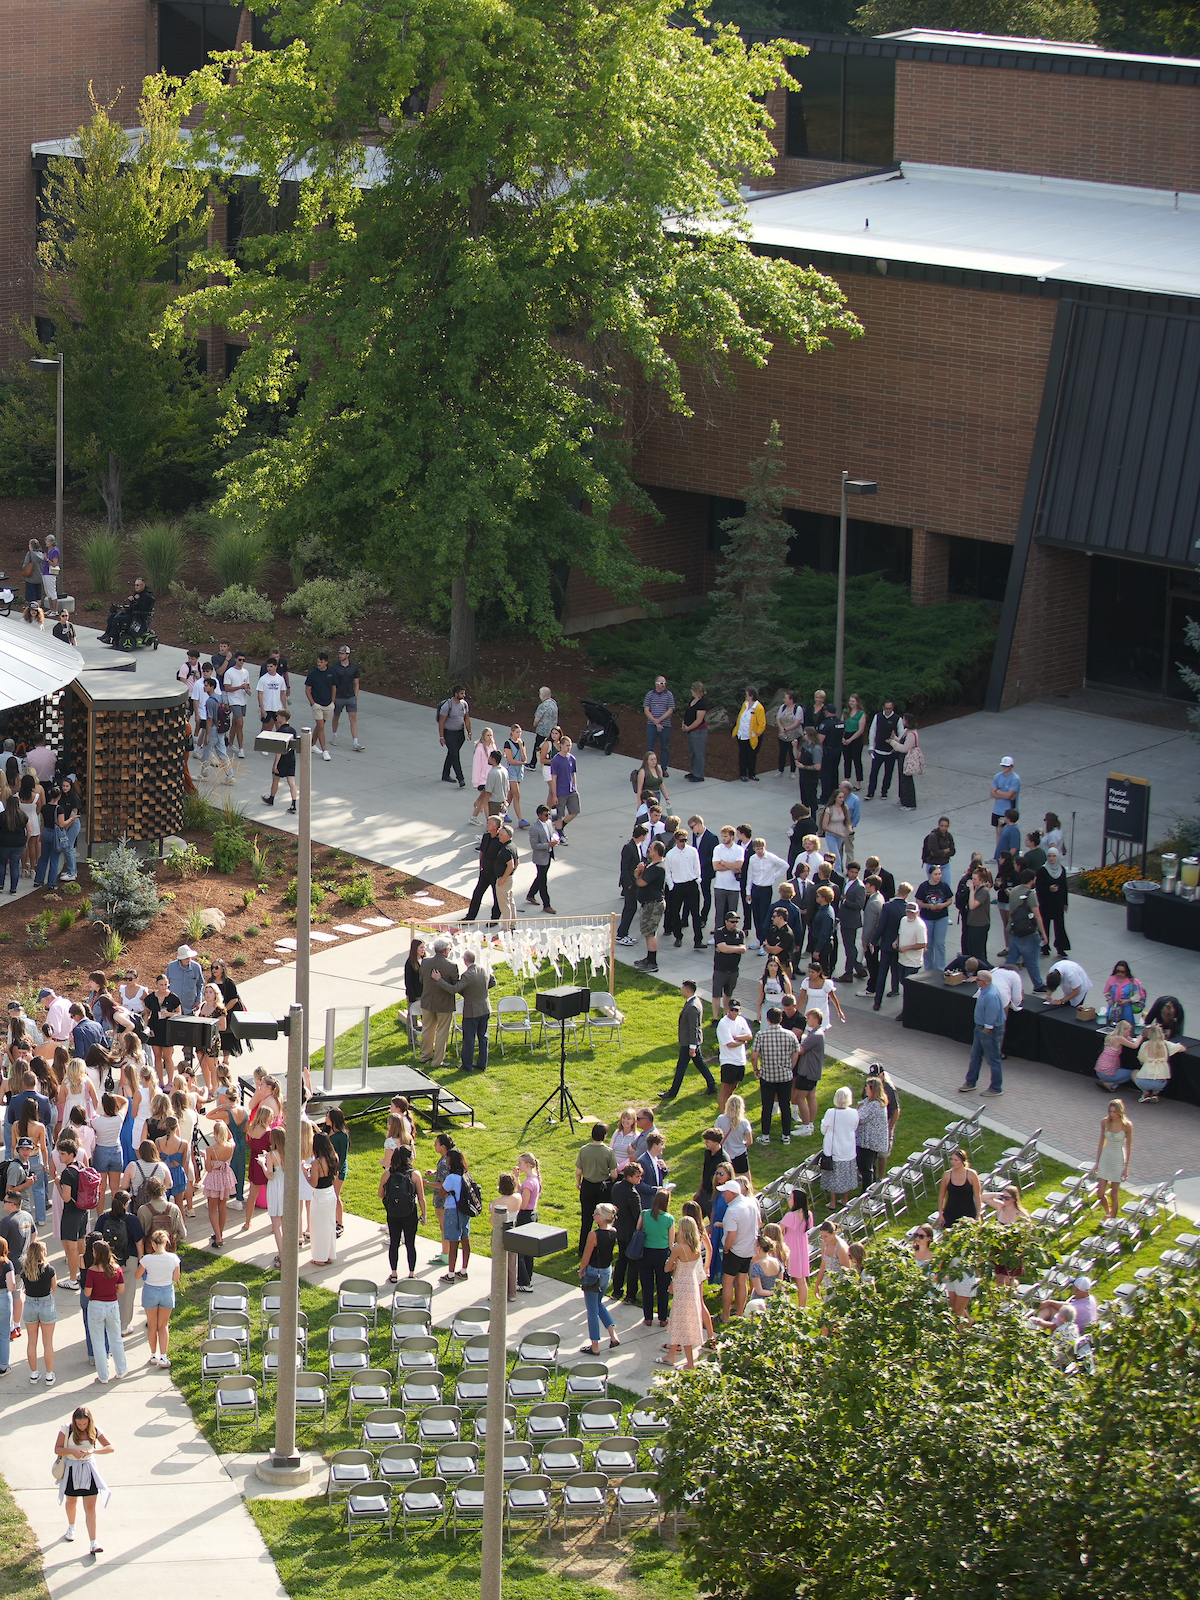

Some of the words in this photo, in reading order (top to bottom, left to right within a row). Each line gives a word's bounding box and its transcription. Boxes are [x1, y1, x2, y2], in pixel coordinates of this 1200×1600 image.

[1109, 788, 1127, 797] Physical
[1109, 796, 1130, 805] Education
[1108, 803, 1126, 813] Building
